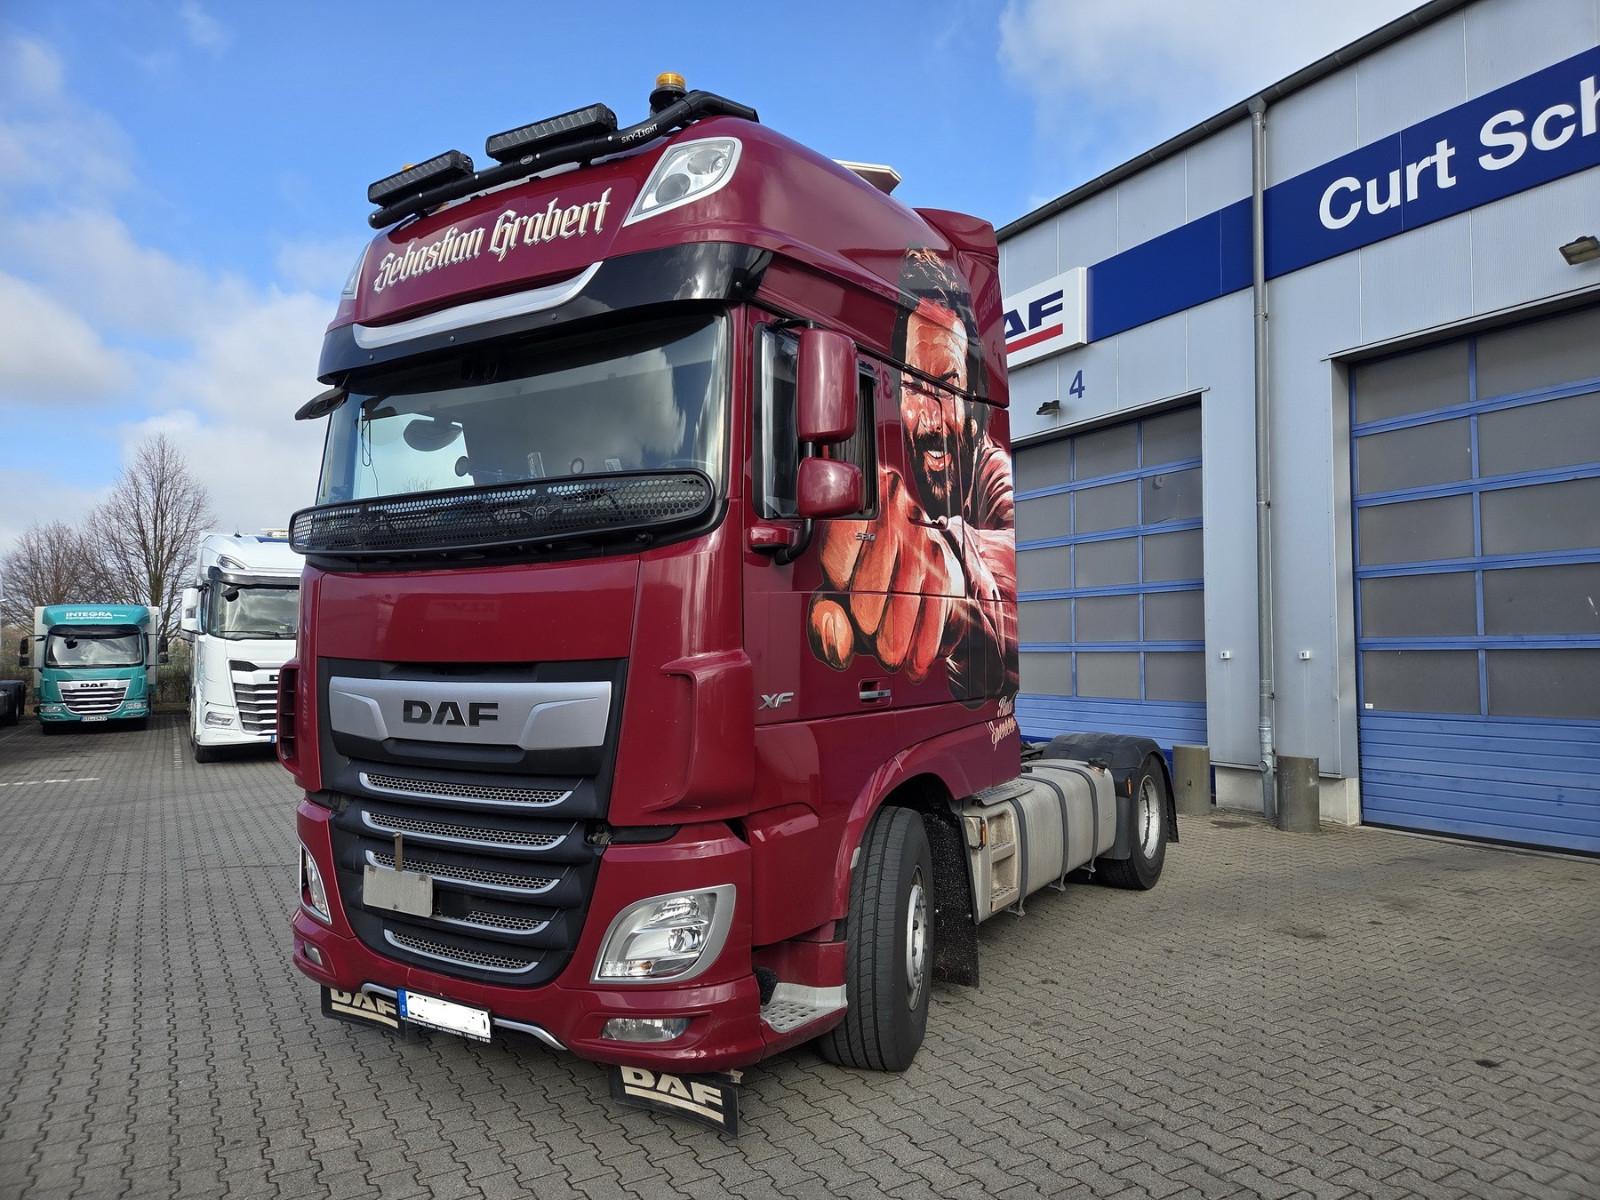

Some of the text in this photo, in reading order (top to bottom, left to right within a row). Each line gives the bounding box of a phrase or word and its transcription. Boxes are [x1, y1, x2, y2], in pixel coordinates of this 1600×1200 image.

[1318, 138, 1457, 230] Curt
[373, 187, 613, 295] Sebastian Grabert
[1003, 289, 1064, 339] AF
[1069, 370, 1086, 399] 4
[403, 699, 499, 728] DAF
[758, 691, 795, 710] XF
[330, 987, 398, 1015] DAF
[620, 1065, 724, 1106] DAF
